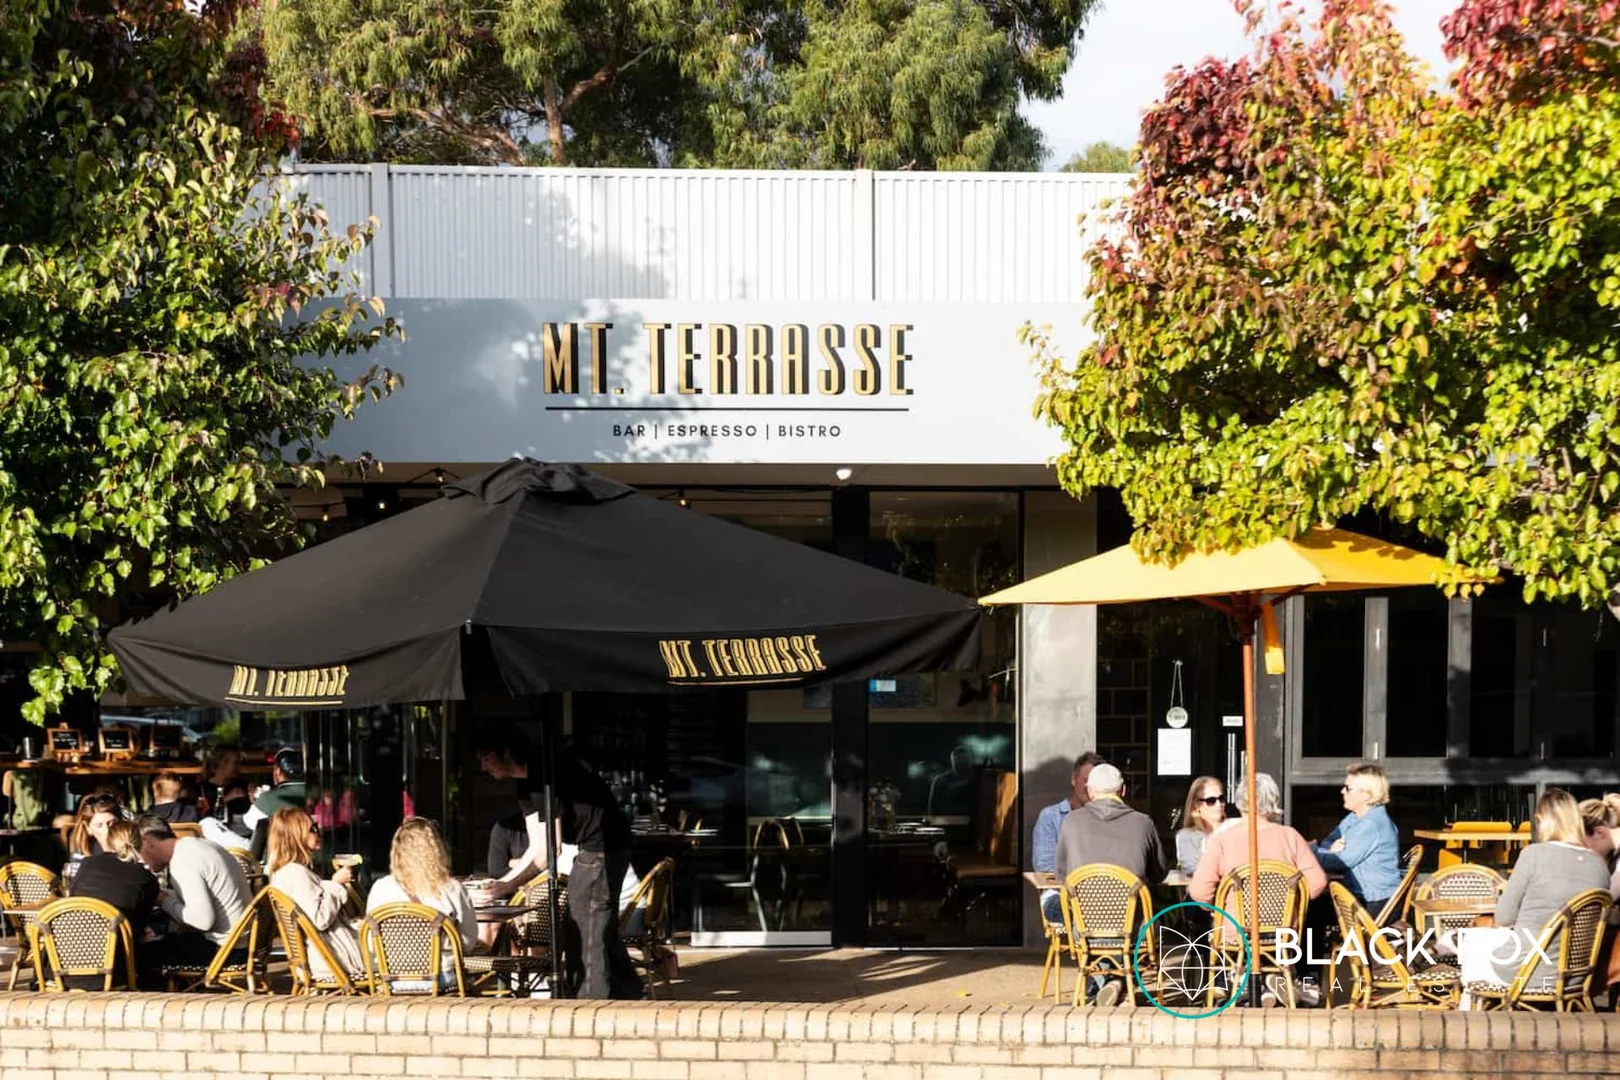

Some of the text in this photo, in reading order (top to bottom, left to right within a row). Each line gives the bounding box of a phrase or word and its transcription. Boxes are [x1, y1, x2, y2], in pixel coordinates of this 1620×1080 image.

[542, 322, 914, 396] MT. TERRASSE
[613, 424, 842, 437] BAR ESPRESSO BISTRO
[659, 634, 827, 678] MT. TERRASSE
